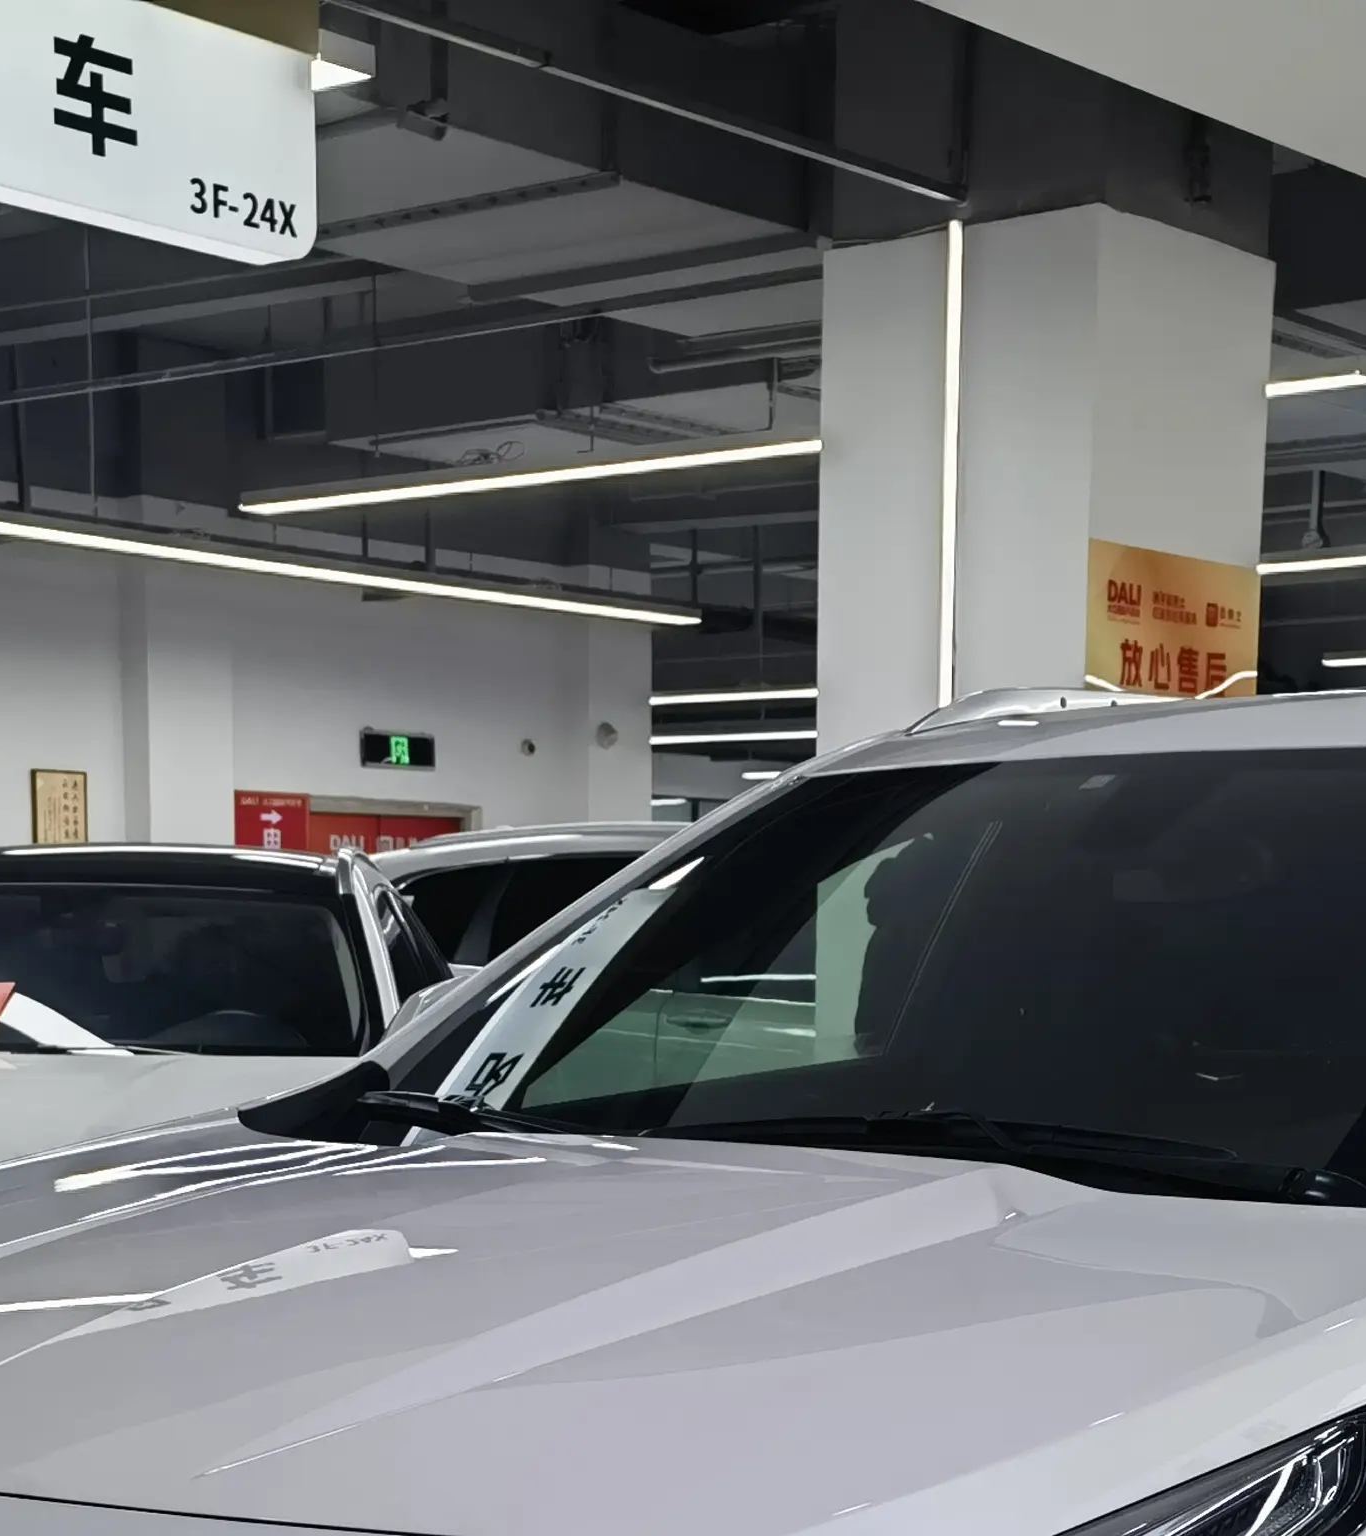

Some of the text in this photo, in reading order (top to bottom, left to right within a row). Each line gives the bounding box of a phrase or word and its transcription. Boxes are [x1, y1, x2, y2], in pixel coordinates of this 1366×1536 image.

[190, 177, 297, 238] 3F-24X
[1107, 579, 1142, 606] DALI
[1119, 638, 1227, 697] 放心售后
